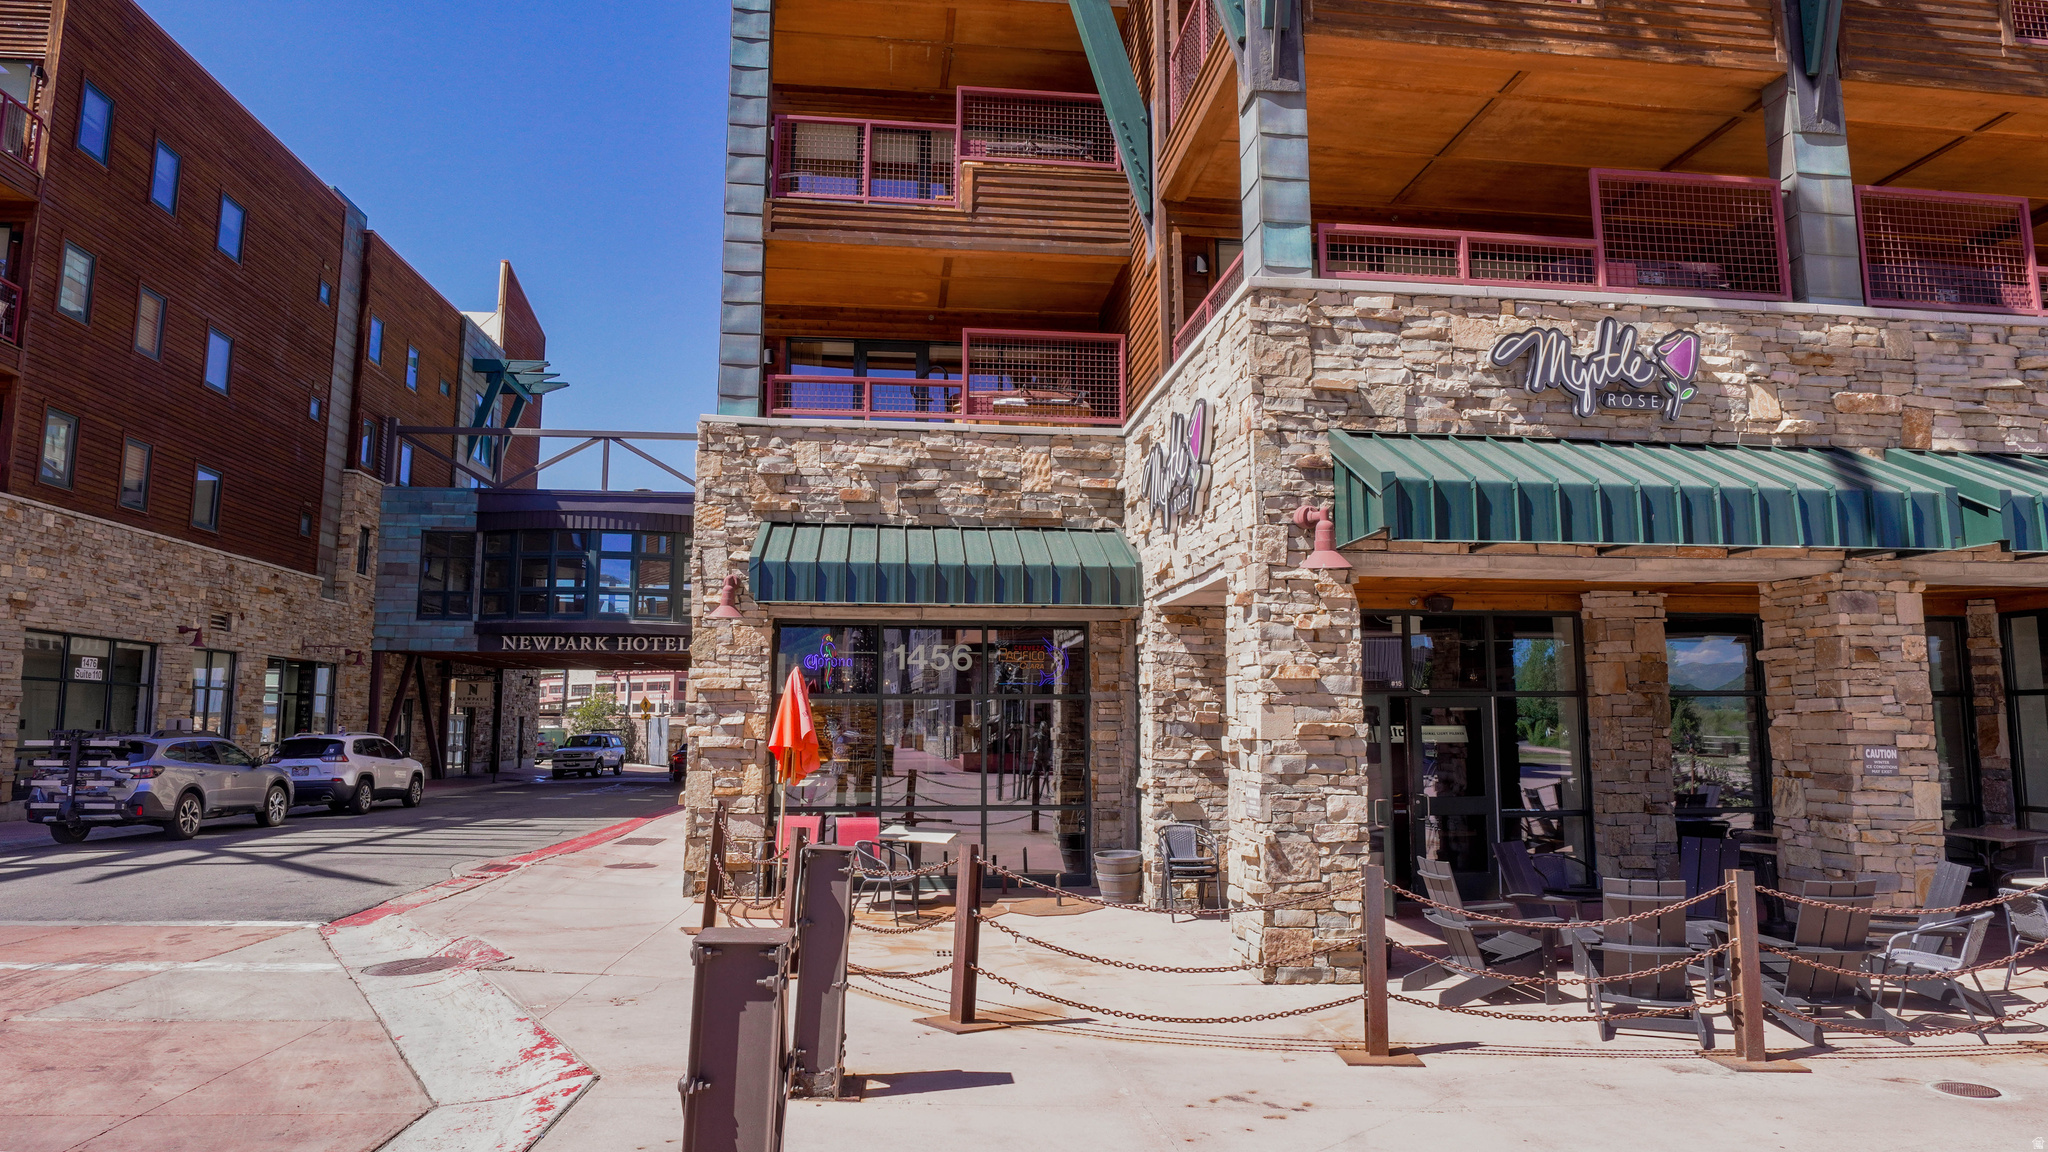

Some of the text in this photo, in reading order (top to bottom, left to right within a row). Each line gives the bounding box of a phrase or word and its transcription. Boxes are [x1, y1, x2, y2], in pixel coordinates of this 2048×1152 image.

[1607, 393, 1659, 409] ROSE
[1173, 489, 1190, 511] ROSE
[501, 635, 690, 652] NEWPARK HOTEL
[893, 644, 973, 672] 1456
[998, 648, 1045, 661] PACIFICO
[82, 658, 97, 668] 1476
[803, 654, 853, 671] Corona
[75, 669, 102, 680] Suite 110
[468, 683, 479, 695] N
[1865, 749, 1897, 758] CAUTION
